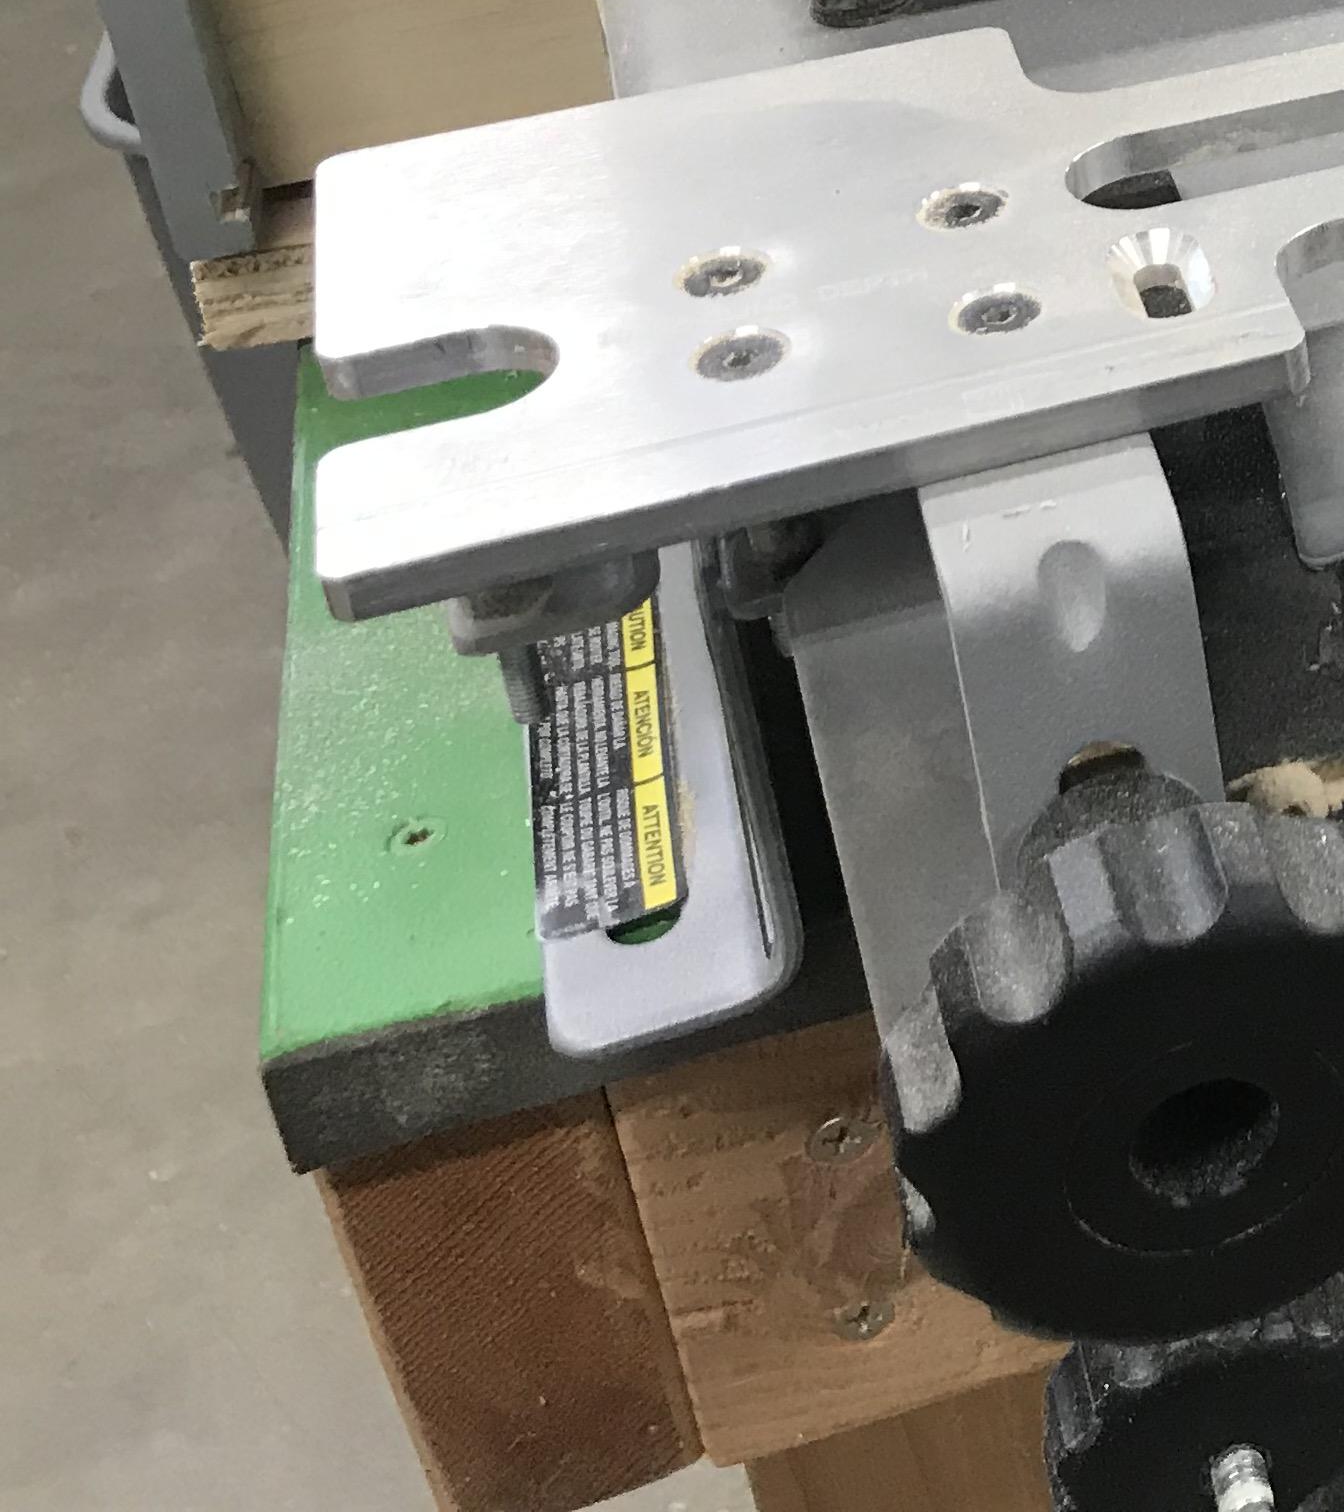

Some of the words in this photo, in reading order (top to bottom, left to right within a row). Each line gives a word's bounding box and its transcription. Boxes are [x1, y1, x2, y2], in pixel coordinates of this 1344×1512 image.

[628, 609, 648, 652] UTION
[633, 690, 656, 758] ATENCIÓN
[642, 804, 667, 886] ATTENTION
